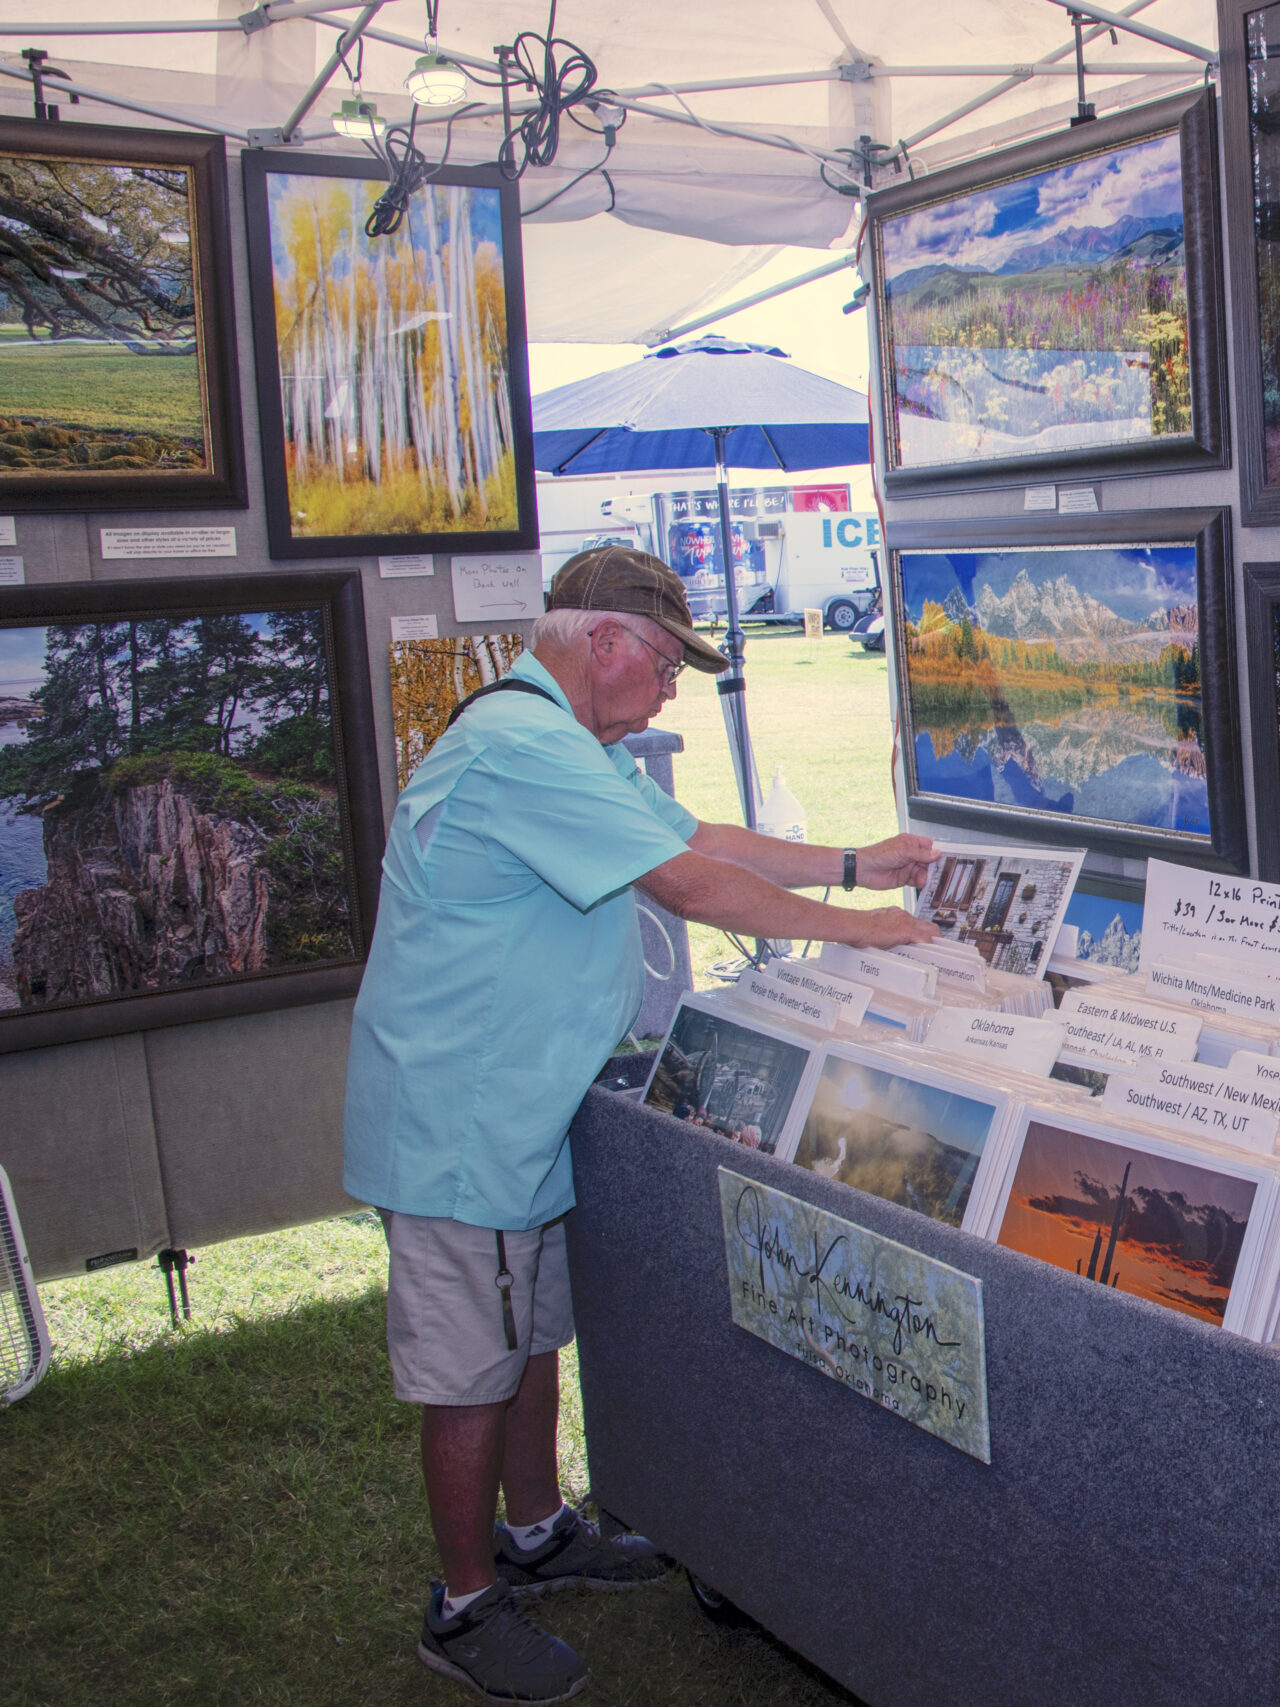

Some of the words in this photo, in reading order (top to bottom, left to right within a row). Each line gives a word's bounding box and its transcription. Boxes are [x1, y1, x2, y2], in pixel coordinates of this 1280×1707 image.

[705, 498, 741, 510] WHRE
[764, 496, 785, 507] BE!
[822, 518, 880, 548] ICE
[1208, 880, 1242, 901] 12x16
[1173, 898, 1196, 919] $39
[1239, 915, 1264, 931] More
[859, 960, 881, 977] Trains
[932, 963, 975, 982] nsportation
[750, 981, 767, 997] Rosie
[767, 987, 779, 1001] the
[778, 992, 801, 1011] Riveter
[801, 1001, 822, 1020] Series
[776, 968, 800, 986] Vintage
[800, 976, 853, 1005] Military/Aircraft
[1152, 970, 1183, 989] Wichita
[1184, 979, 1253, 1007] Mtns/Medicine
[1253, 995, 1277, 1013] Park
[970, 1018, 1016, 1037] Oklahoma
[1076, 1002, 1109, 1019] Eastern
[1109, 1008, 1119, 1021] &
[1118, 1011, 1159, 1031] Midwest
[1159, 1020, 1177, 1035] U.S.
[965, 1035, 1009, 1050] Arkansas/Kansas
[1105, 1032, 1114, 1046] /
[1112, 1035, 1124, 1050] LA,
[1159, 1069, 1216, 1097] Southwest
[1214, 1082, 1225, 1097] /
[1223, 1085, 1250, 1104] New
[1126, 1088, 1183, 1116] Southwest
[1181, 1102, 1192, 1119] /
[1190, 1106, 1209, 1126] AZ,
[1213, 1110, 1229, 1131] TX,
[1231, 1116, 1251, 1132] UT
[736, 1185, 810, 1293] John
[810, 1230, 961, 1356] Kennington
[742, 1280, 778, 1314] Fine
[787, 1308, 815, 1331] Art
[824, 1324, 967, 1420] Photography
[796, 1342, 831, 1373] Tulsa,
[834, 1365, 900, 1411] Oklahoma
